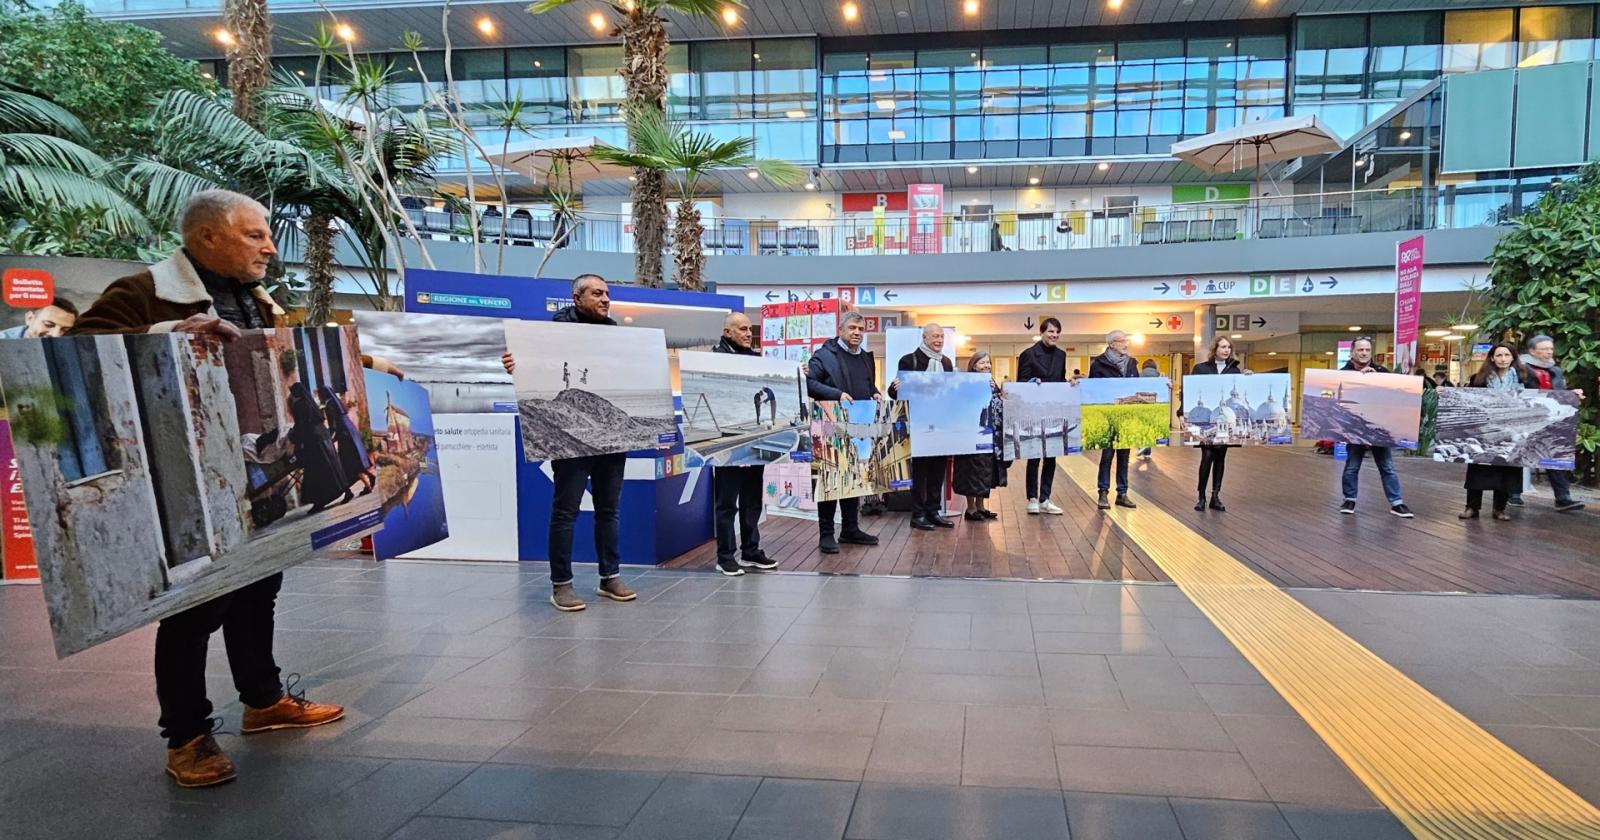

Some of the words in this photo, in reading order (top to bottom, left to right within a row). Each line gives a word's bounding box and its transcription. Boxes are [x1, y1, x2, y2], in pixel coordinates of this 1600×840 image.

[1205, 187, 1219, 201] D
[877, 194, 888, 208] B
[847, 239, 855, 249] B
[1218, 281, 1236, 290] CUP
[1254, 279, 1267, 292] D
[1280, 279, 1290, 292] E
[841, 290, 851, 303] B
[862, 290, 872, 302] A
[1051, 286, 1061, 299] C
[434, 295, 468, 304] REGIONE
[479, 297, 508, 306] VENETO
[865, 320, 875, 330] B
[1217, 317, 1227, 328] D
[1236, 317, 1245, 328] E
[444, 427, 462, 436] salute
[656, 461, 663, 476] A
[666, 459, 672, 474] B
